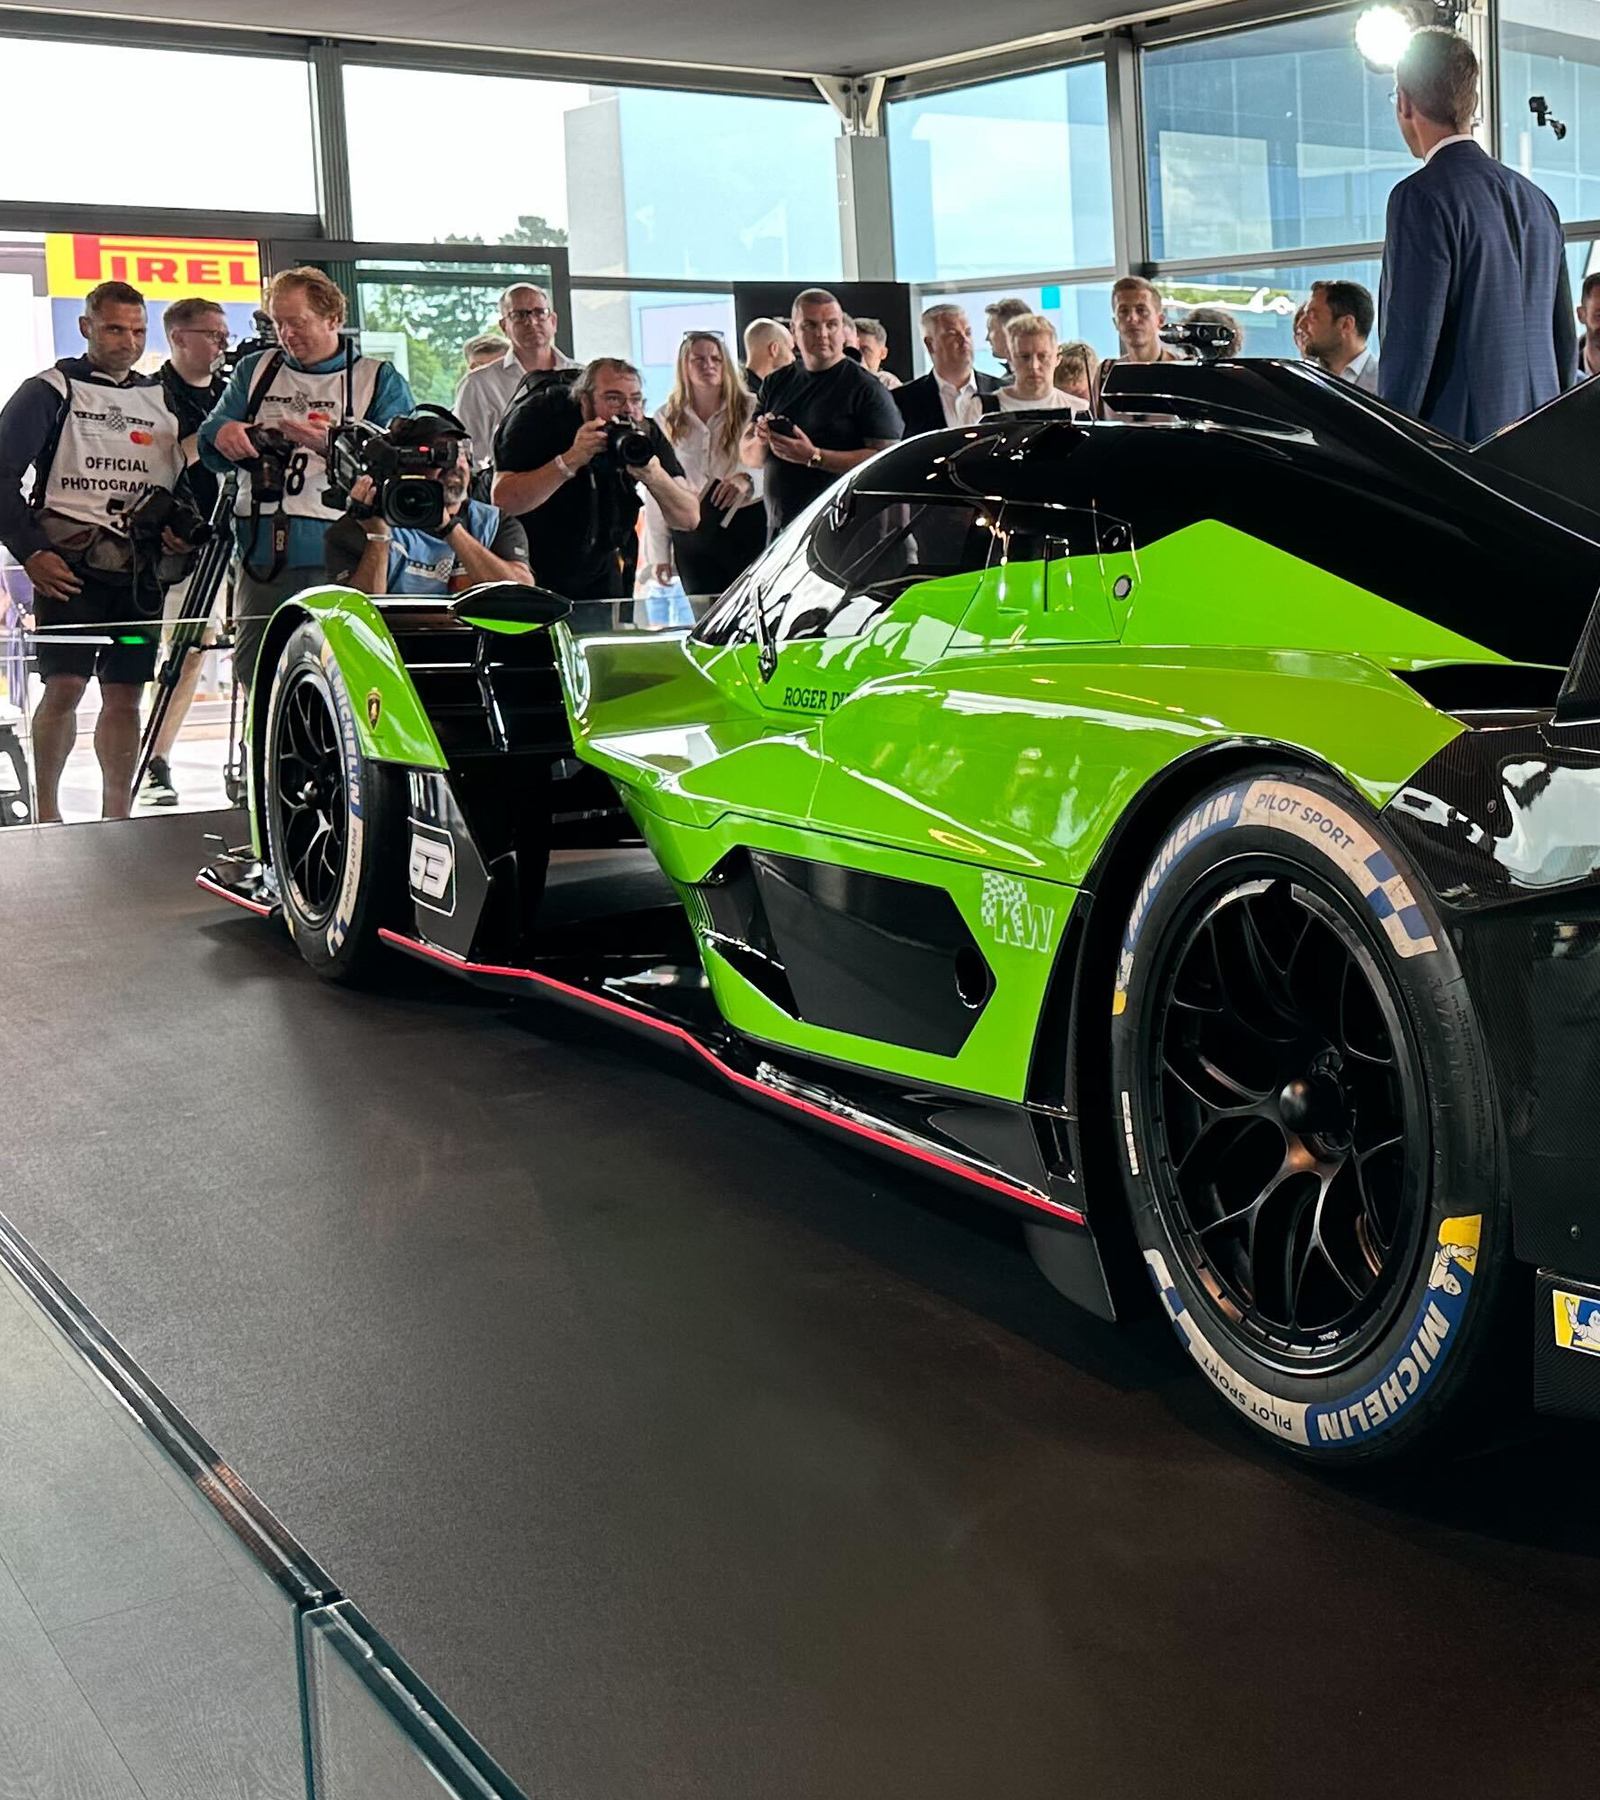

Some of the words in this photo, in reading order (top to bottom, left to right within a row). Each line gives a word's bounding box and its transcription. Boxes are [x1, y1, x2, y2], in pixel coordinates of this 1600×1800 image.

[72, 234, 261, 286] PIREL
[85, 456, 149, 473] OFFICIAL
[286, 453, 309, 496] 8
[783, 687, 828, 710] ROGER
[1255, 793, 1302, 814] PILOT
[1300, 806, 1355, 850] SPORT
[1129, 791, 1237, 943] MICHELIN
[994, 897, 1054, 953] KW
[1202, 1357, 1247, 1404] SPORT
[1317, 1300, 1451, 1442] MICHELIN
[1250, 1406, 1293, 1431] PILOT
